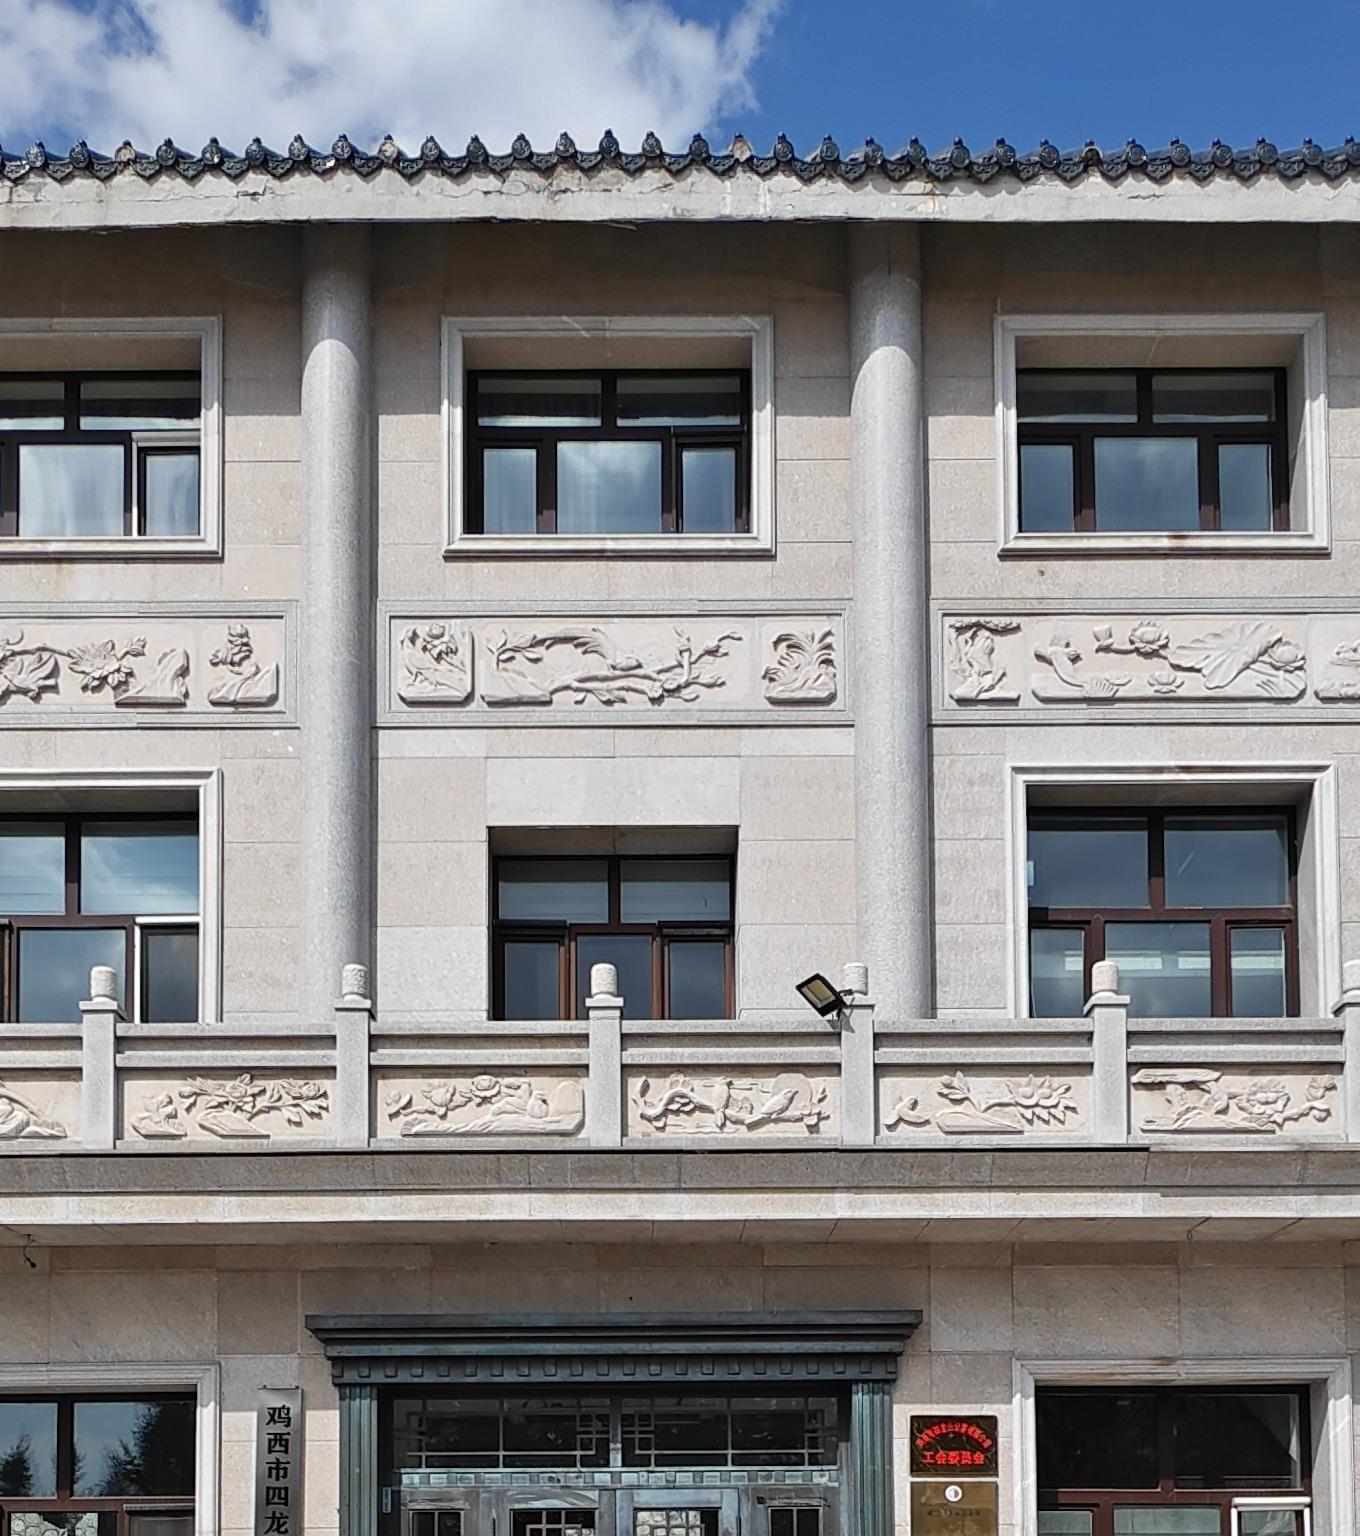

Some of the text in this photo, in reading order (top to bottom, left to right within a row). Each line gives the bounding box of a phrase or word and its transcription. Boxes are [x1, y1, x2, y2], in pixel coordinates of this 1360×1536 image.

[921, 1450, 985, 1465] 工会委员会
